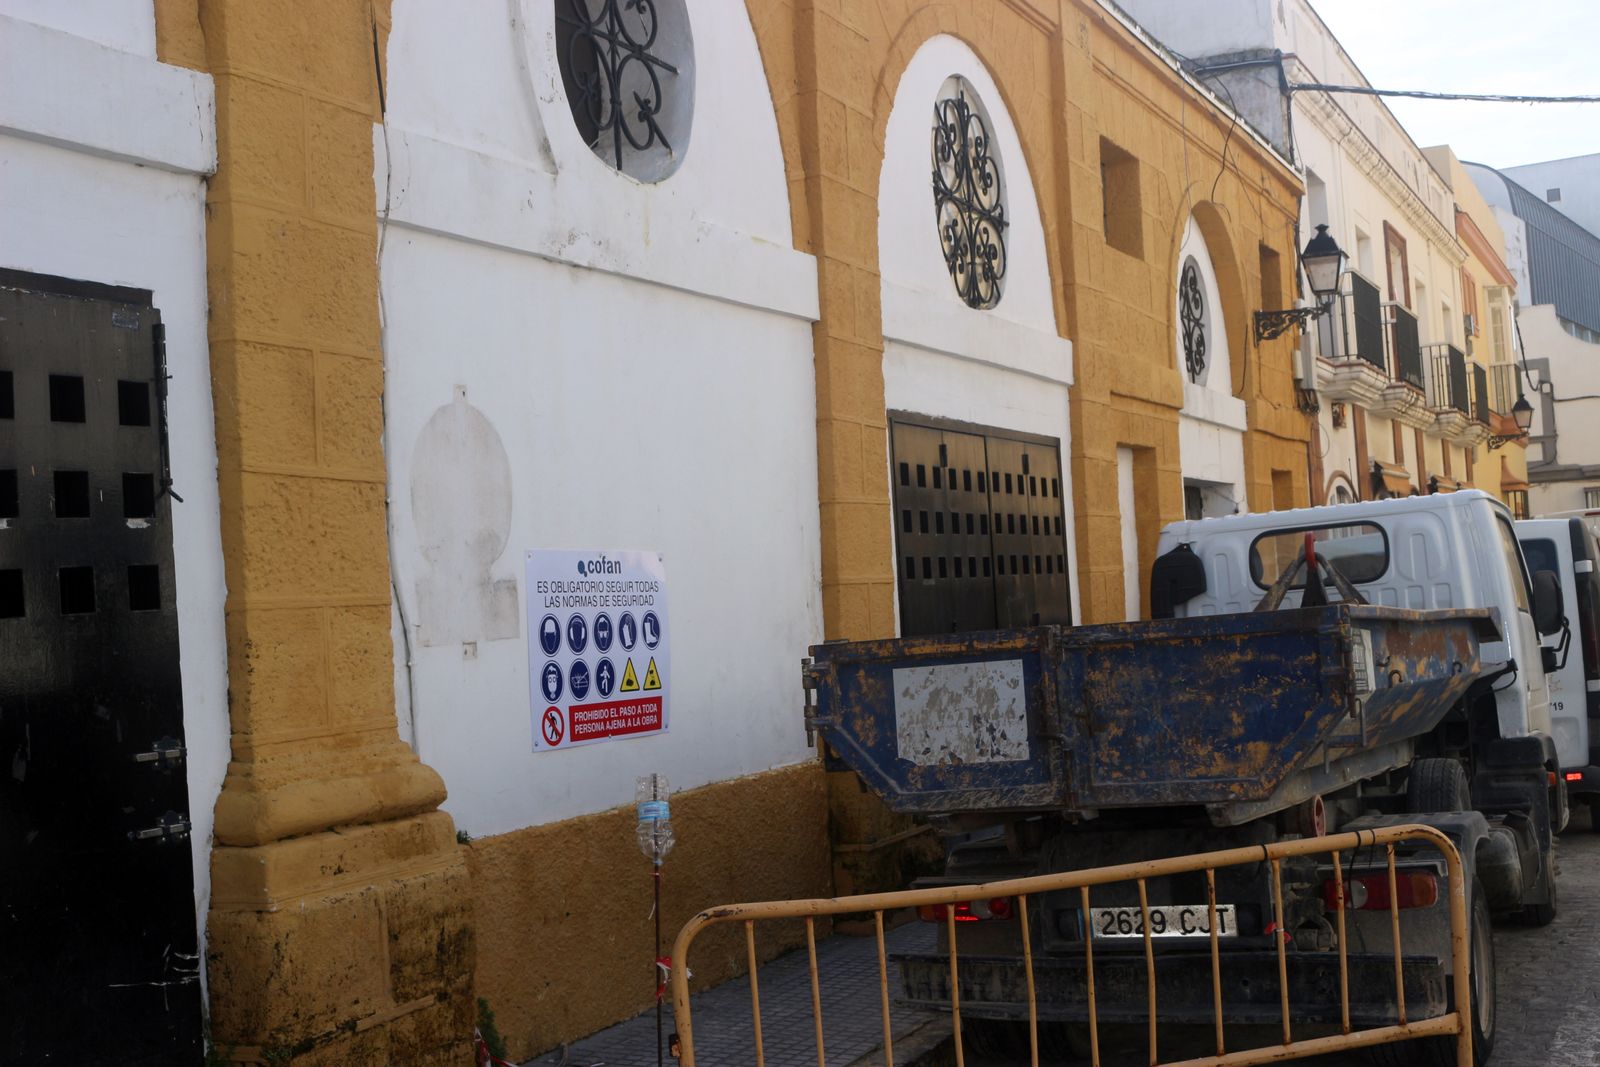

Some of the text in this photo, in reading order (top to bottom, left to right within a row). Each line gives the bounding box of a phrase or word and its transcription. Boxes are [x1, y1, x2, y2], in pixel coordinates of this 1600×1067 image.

[587, 556, 622, 574] cofan
[537, 581, 659, 593] ES OBLIGATORIO SEGUIR TODAS
[544, 594, 654, 608] LAS NORMAS DE SEGURIDAD
[574, 703, 657, 722] PROHIBIDO EL PASO A TODA
[574, 715, 657, 734] PERSONA AJENA A LA OBRA
[1101, 909, 1167, 935] 2629
